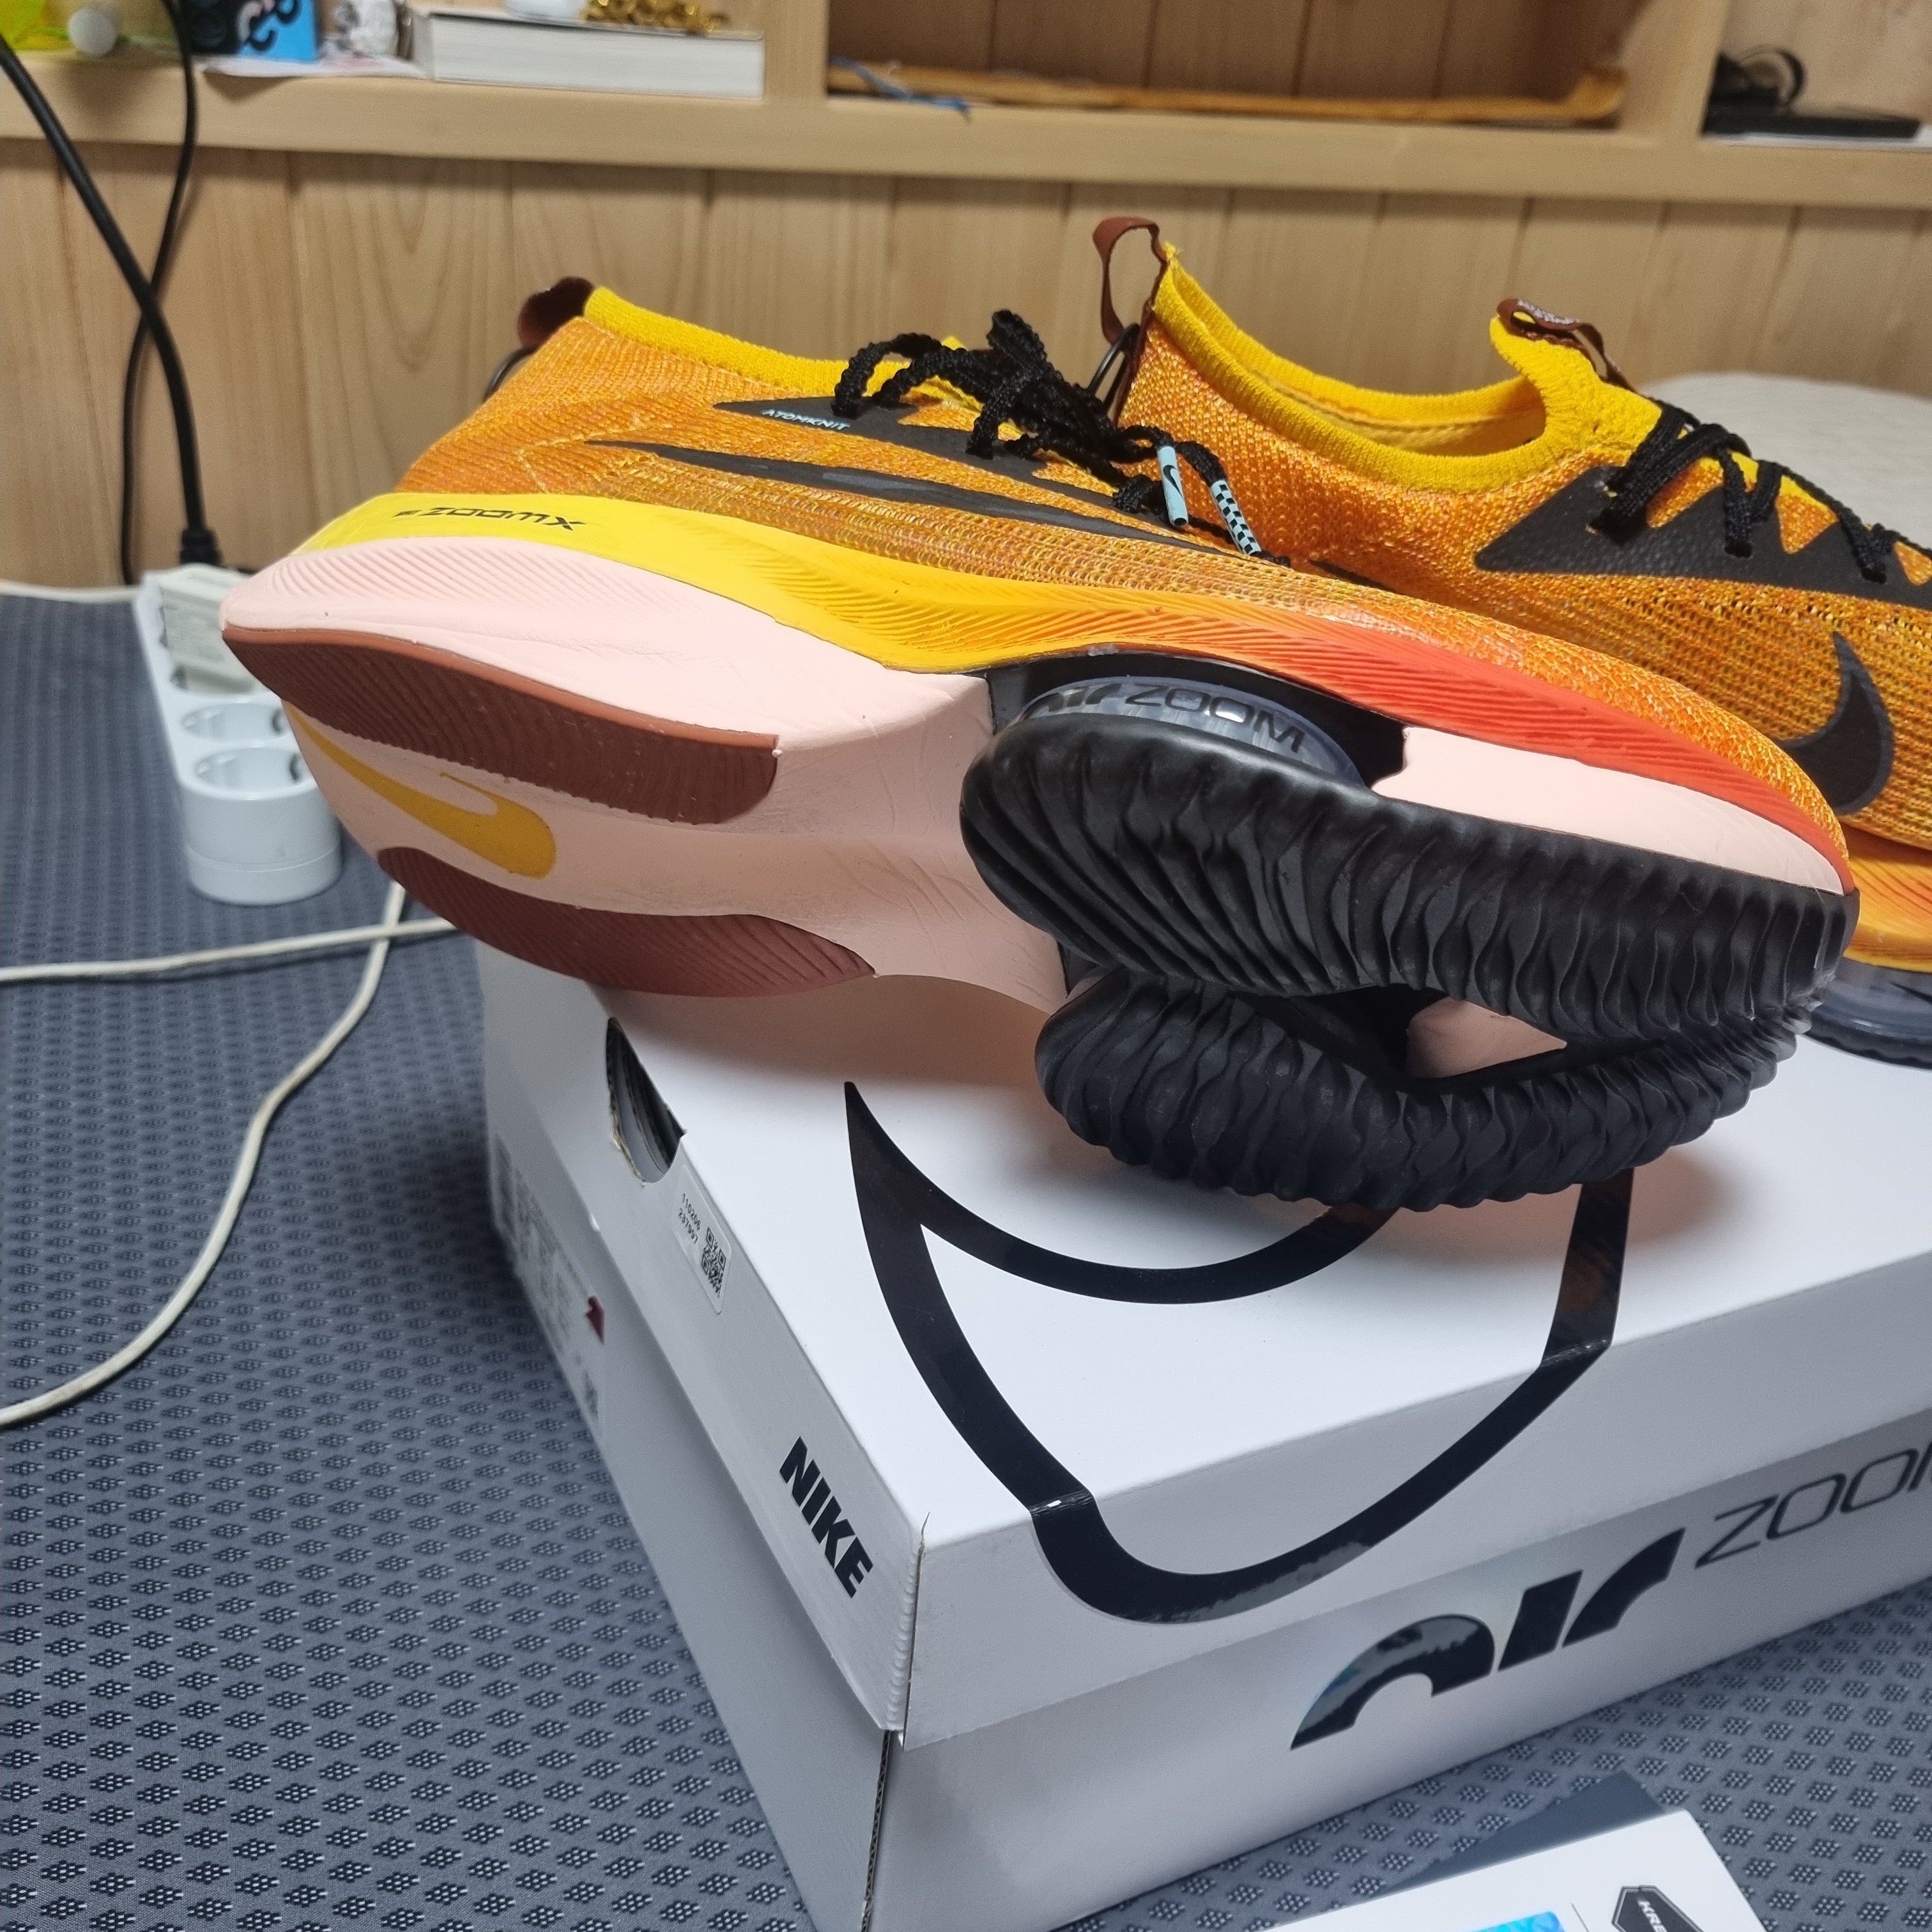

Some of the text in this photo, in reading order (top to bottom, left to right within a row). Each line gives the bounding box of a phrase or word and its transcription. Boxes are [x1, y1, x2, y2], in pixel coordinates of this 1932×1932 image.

[760, 409, 851, 431] ATOMKNIT
[1124, 684, 1307, 754] ZOOM
[778, 1435, 874, 1599] NIKE
